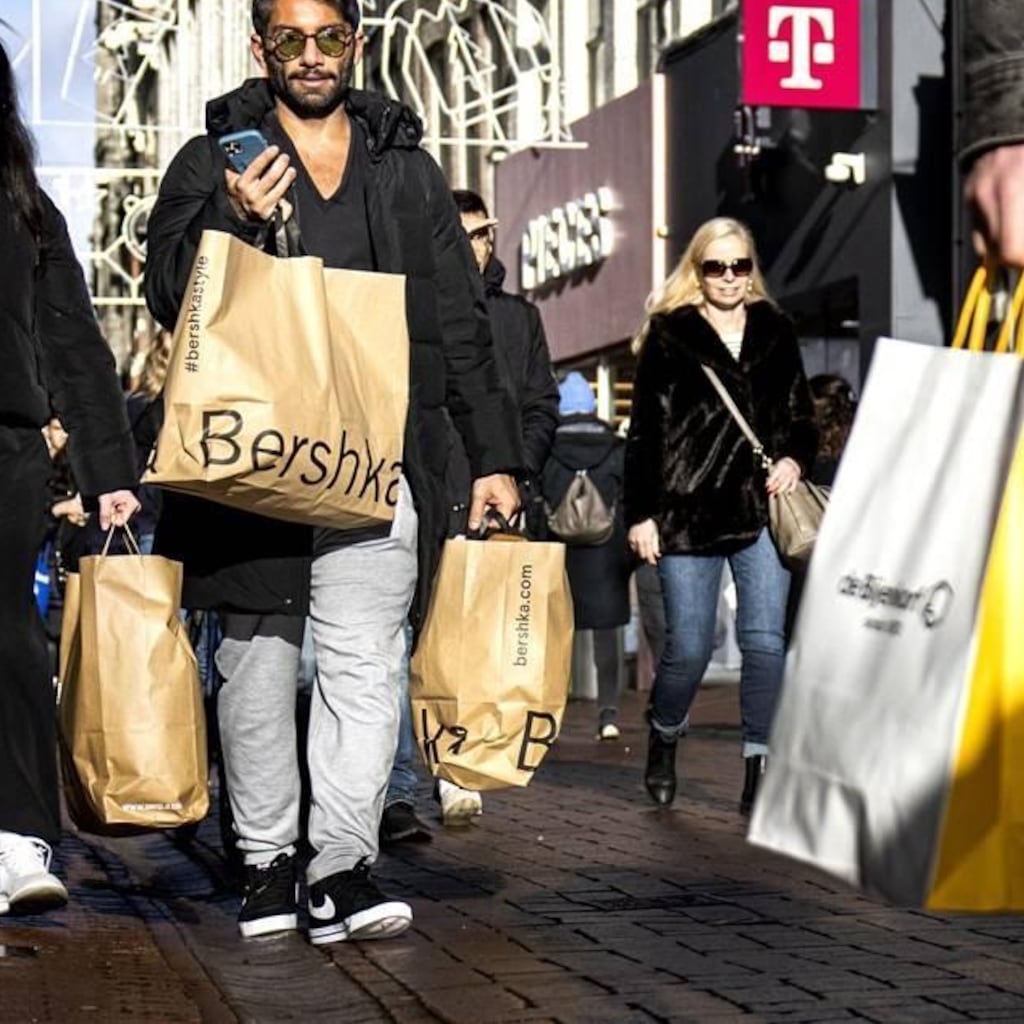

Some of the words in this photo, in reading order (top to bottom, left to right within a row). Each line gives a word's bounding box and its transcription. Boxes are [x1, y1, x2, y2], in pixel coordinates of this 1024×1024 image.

[768, 5, 834, 90] T
[184, 255, 210, 373] #bershkastyle
[513, 564, 533, 666] bershka.com
